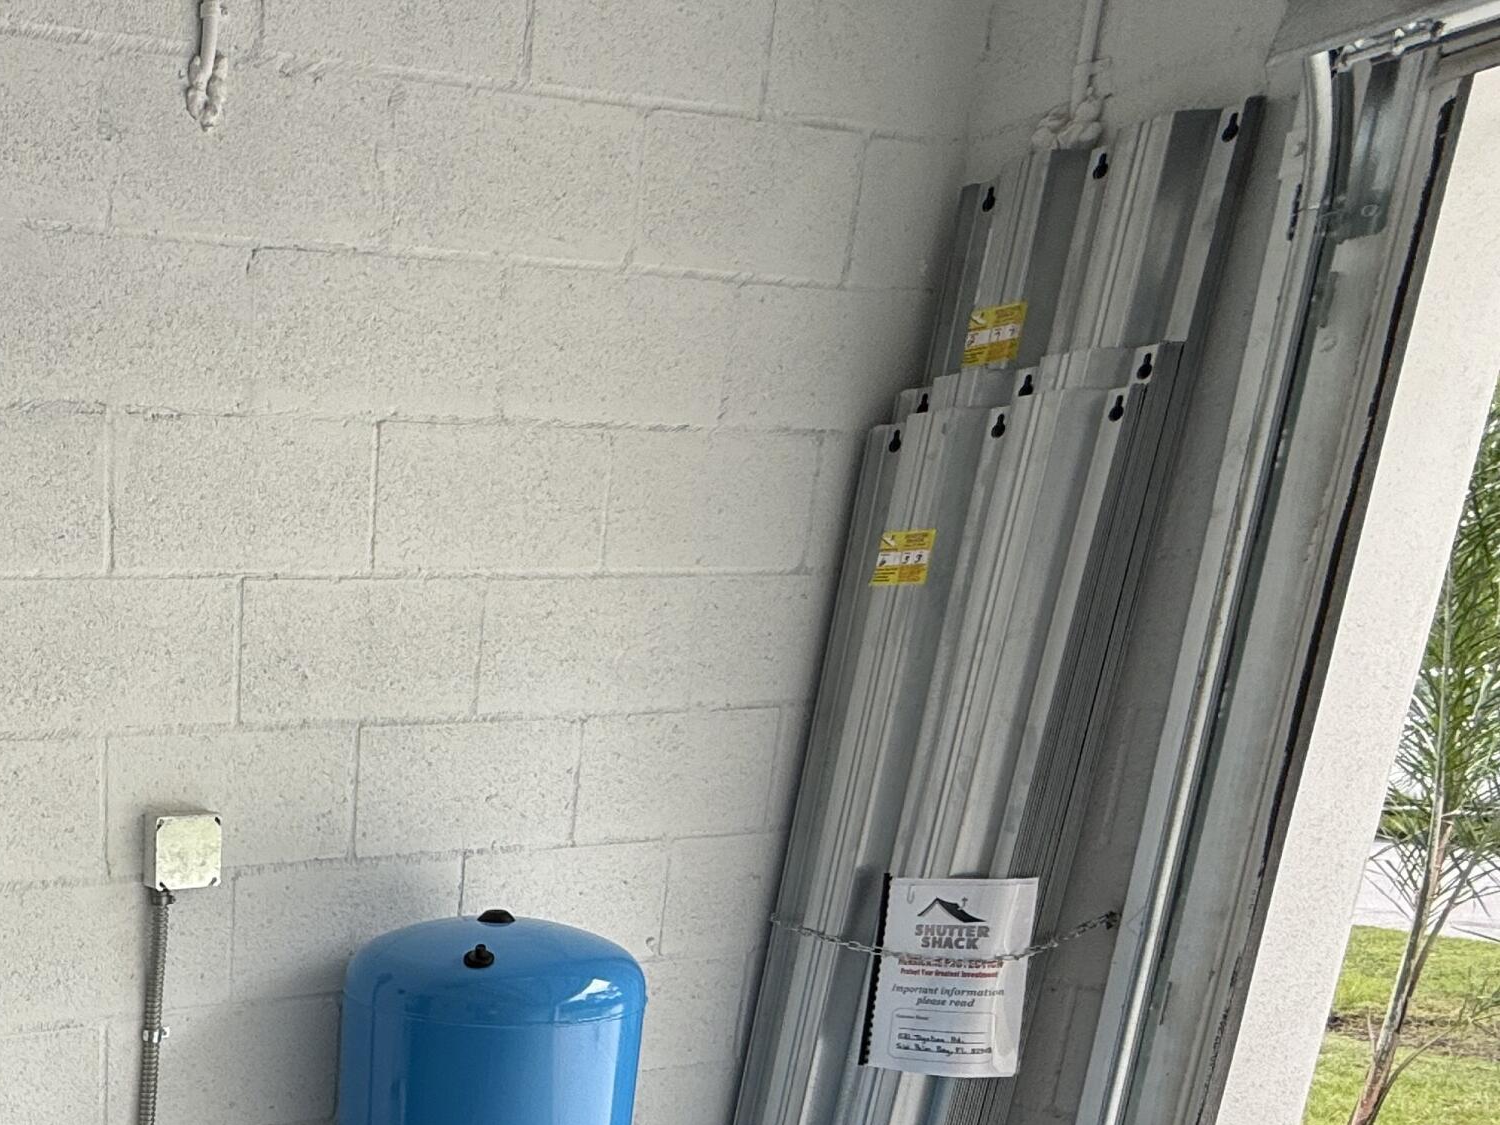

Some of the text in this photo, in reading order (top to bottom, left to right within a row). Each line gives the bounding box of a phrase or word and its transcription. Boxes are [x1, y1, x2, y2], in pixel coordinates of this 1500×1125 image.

[914, 924, 990, 938] SHUTTER
[920, 937, 979, 950] SHACK
[891, 984, 1005, 996] Important information
[915, 996, 976, 1008] please read
